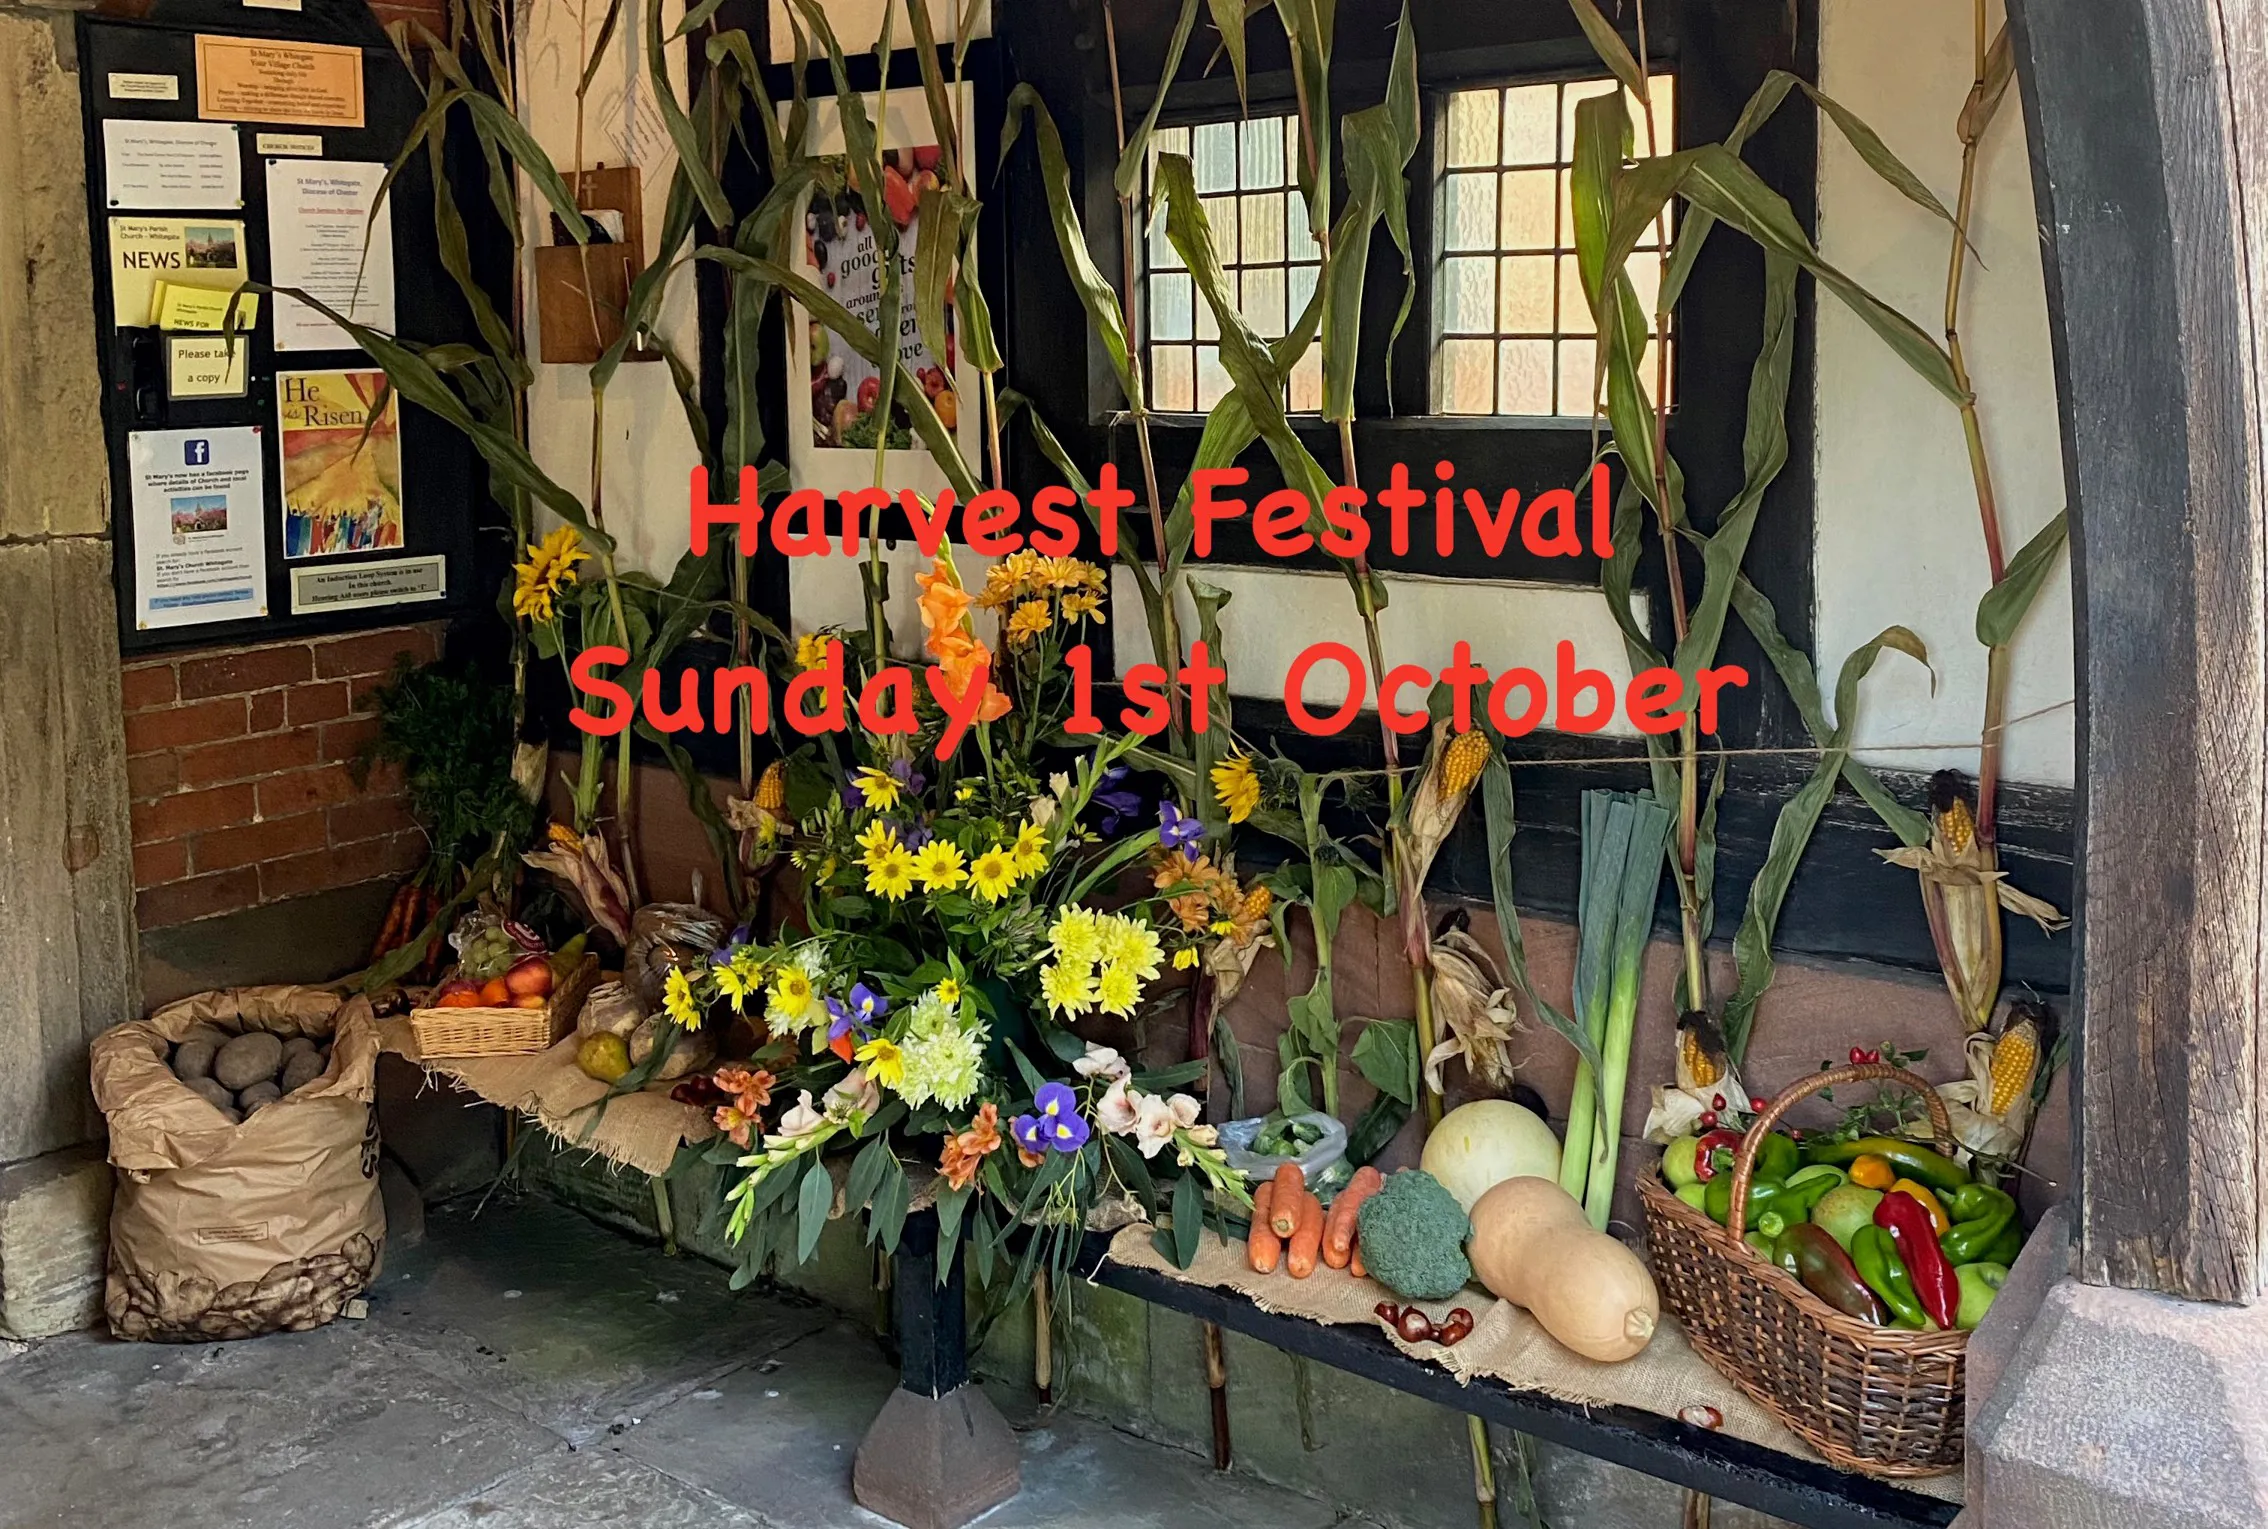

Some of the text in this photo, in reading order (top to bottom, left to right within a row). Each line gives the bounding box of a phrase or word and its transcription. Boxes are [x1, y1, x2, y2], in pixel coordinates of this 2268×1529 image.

[857, 236, 872, 253] all
[123, 251, 181, 269] NEWS
[174, 318, 194, 328] NEWS
[178, 348, 236, 358] Please tak
[196, 374, 220, 384] copy
[285, 377, 320, 403] He
[284, 404, 366, 427] is Risen
[370, 590, 388, 598] please
